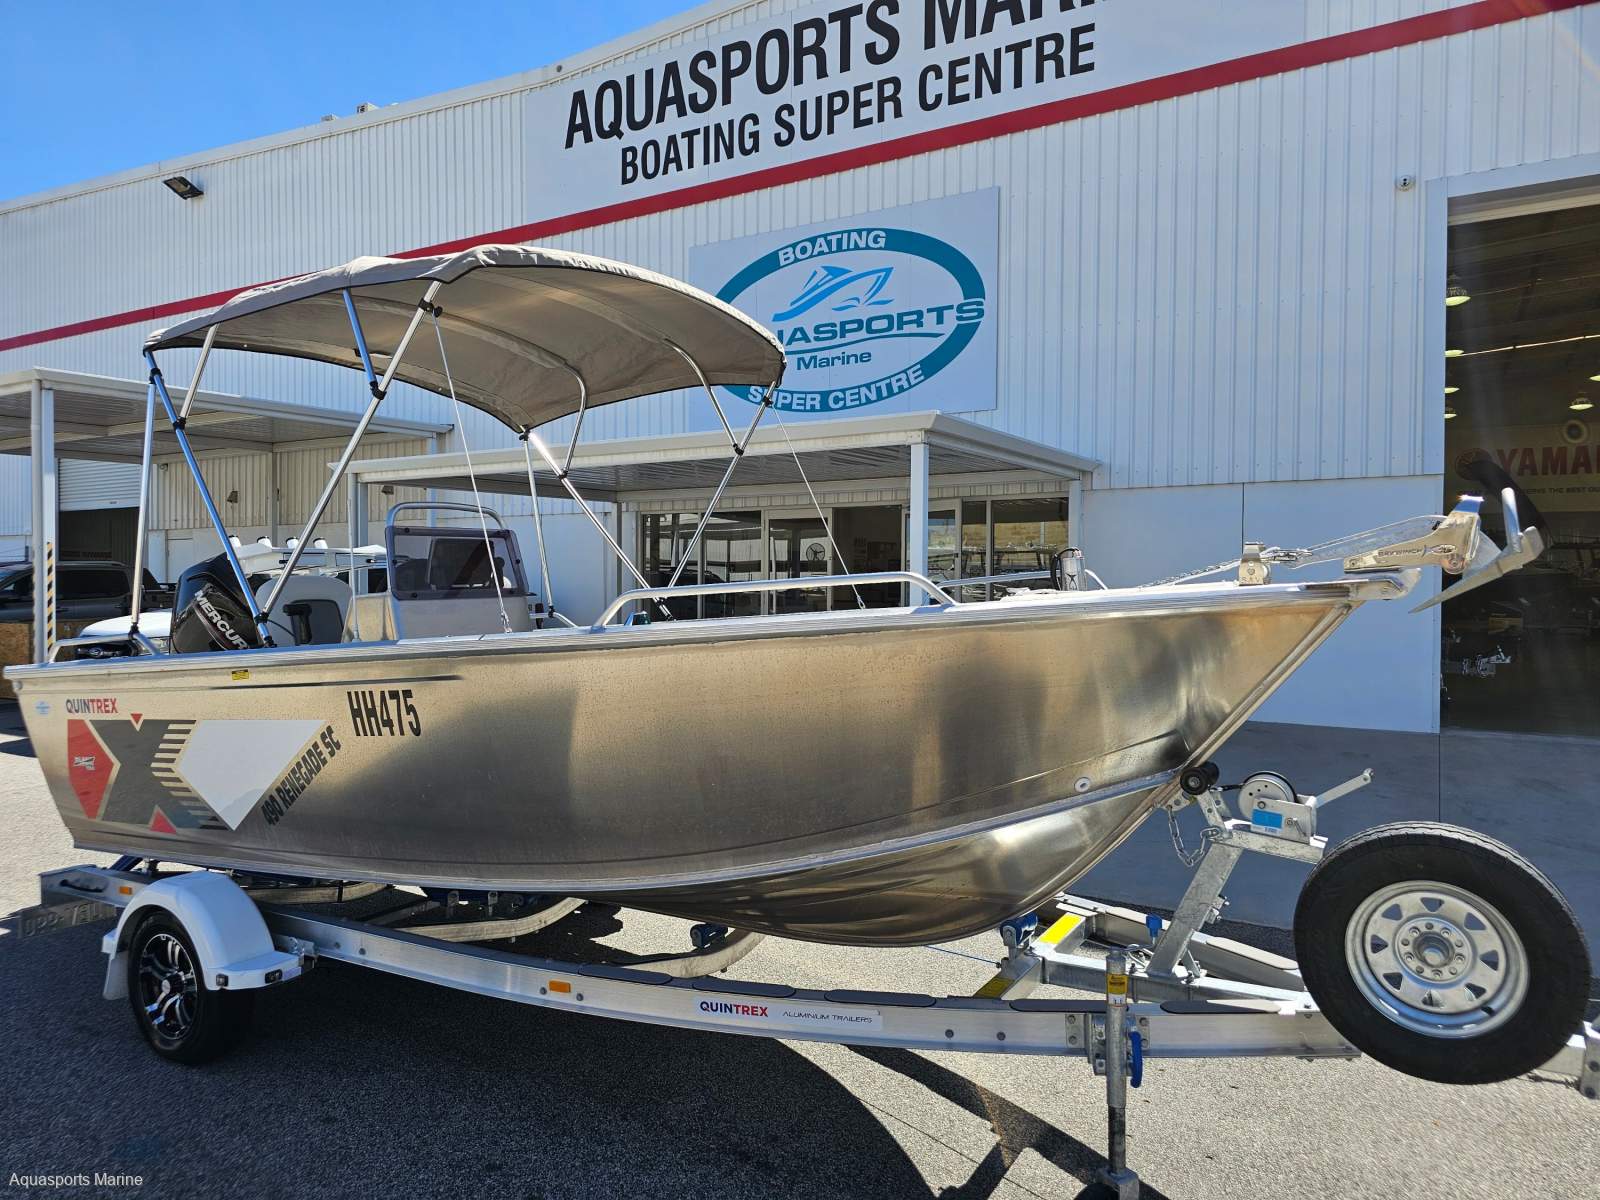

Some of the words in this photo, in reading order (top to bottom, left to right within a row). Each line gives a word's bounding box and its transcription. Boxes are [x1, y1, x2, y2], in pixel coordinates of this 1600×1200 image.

[565, 0, 900, 148] AQUASPORTS
[620, 112, 760, 185] BOATING
[774, 75, 902, 146] SUPER
[918, 23, 1095, 111] CENTRE
[778, 230, 886, 266] BOATING
[797, 352, 871, 371] Marine
[747, 386, 821, 410] SUPER
[828, 364, 925, 410] CENTRE
[194, 588, 248, 649] MERCUR
[65, 698, 118, 714] QUINTREX
[347, 689, 421, 736] HH475
[260, 794, 284, 825] 490
[274, 741, 328, 810] RENEGADE
[320, 725, 341, 758] SC
[700, 1001, 768, 1017] QUINTREX
[782, 1011, 829, 1020] ALUMINIUM
[831, 1014, 873, 1024] TRAILERS
